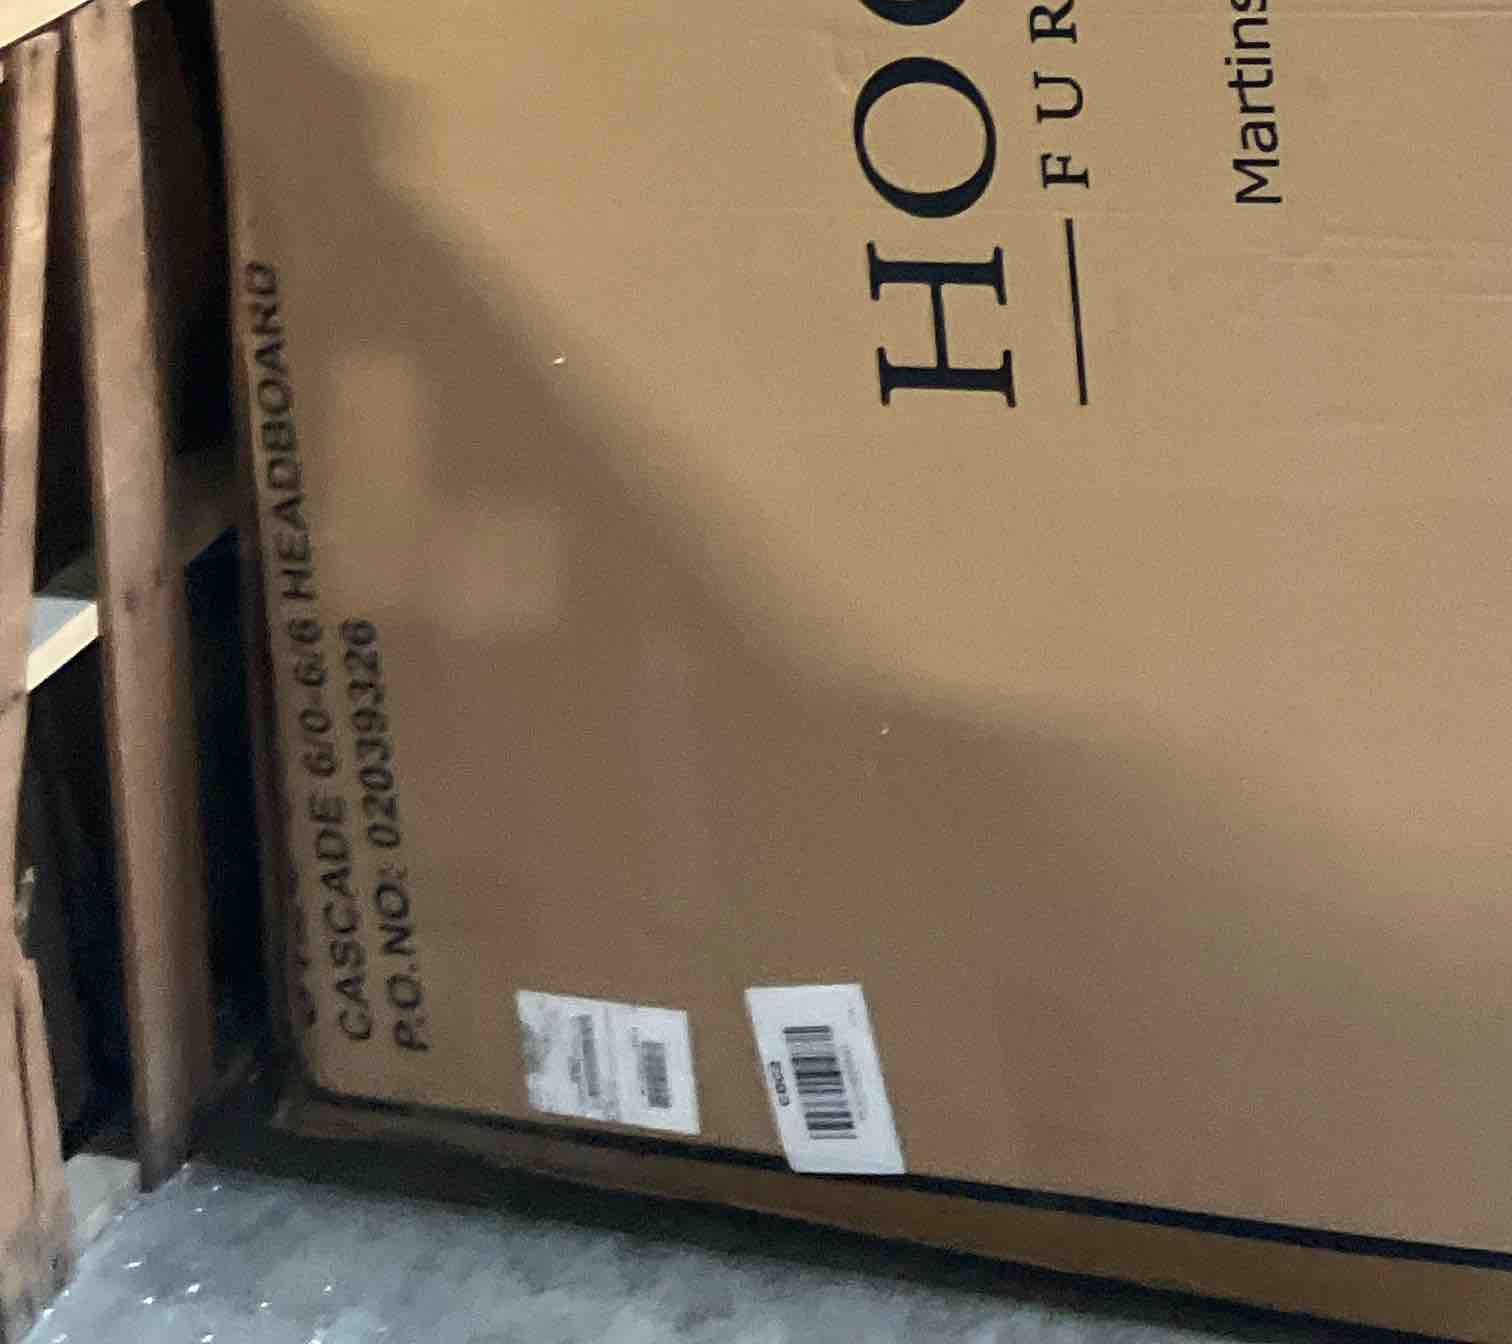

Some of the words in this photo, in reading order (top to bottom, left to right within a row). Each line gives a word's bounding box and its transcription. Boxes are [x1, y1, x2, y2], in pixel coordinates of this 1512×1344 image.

[245, 261, 319, 600] HEADBOARD
[285, 617, 343, 779] 6/0-6/6
[340, 618, 404, 848] 02039326
[308, 795, 374, 1041] CASCADE
